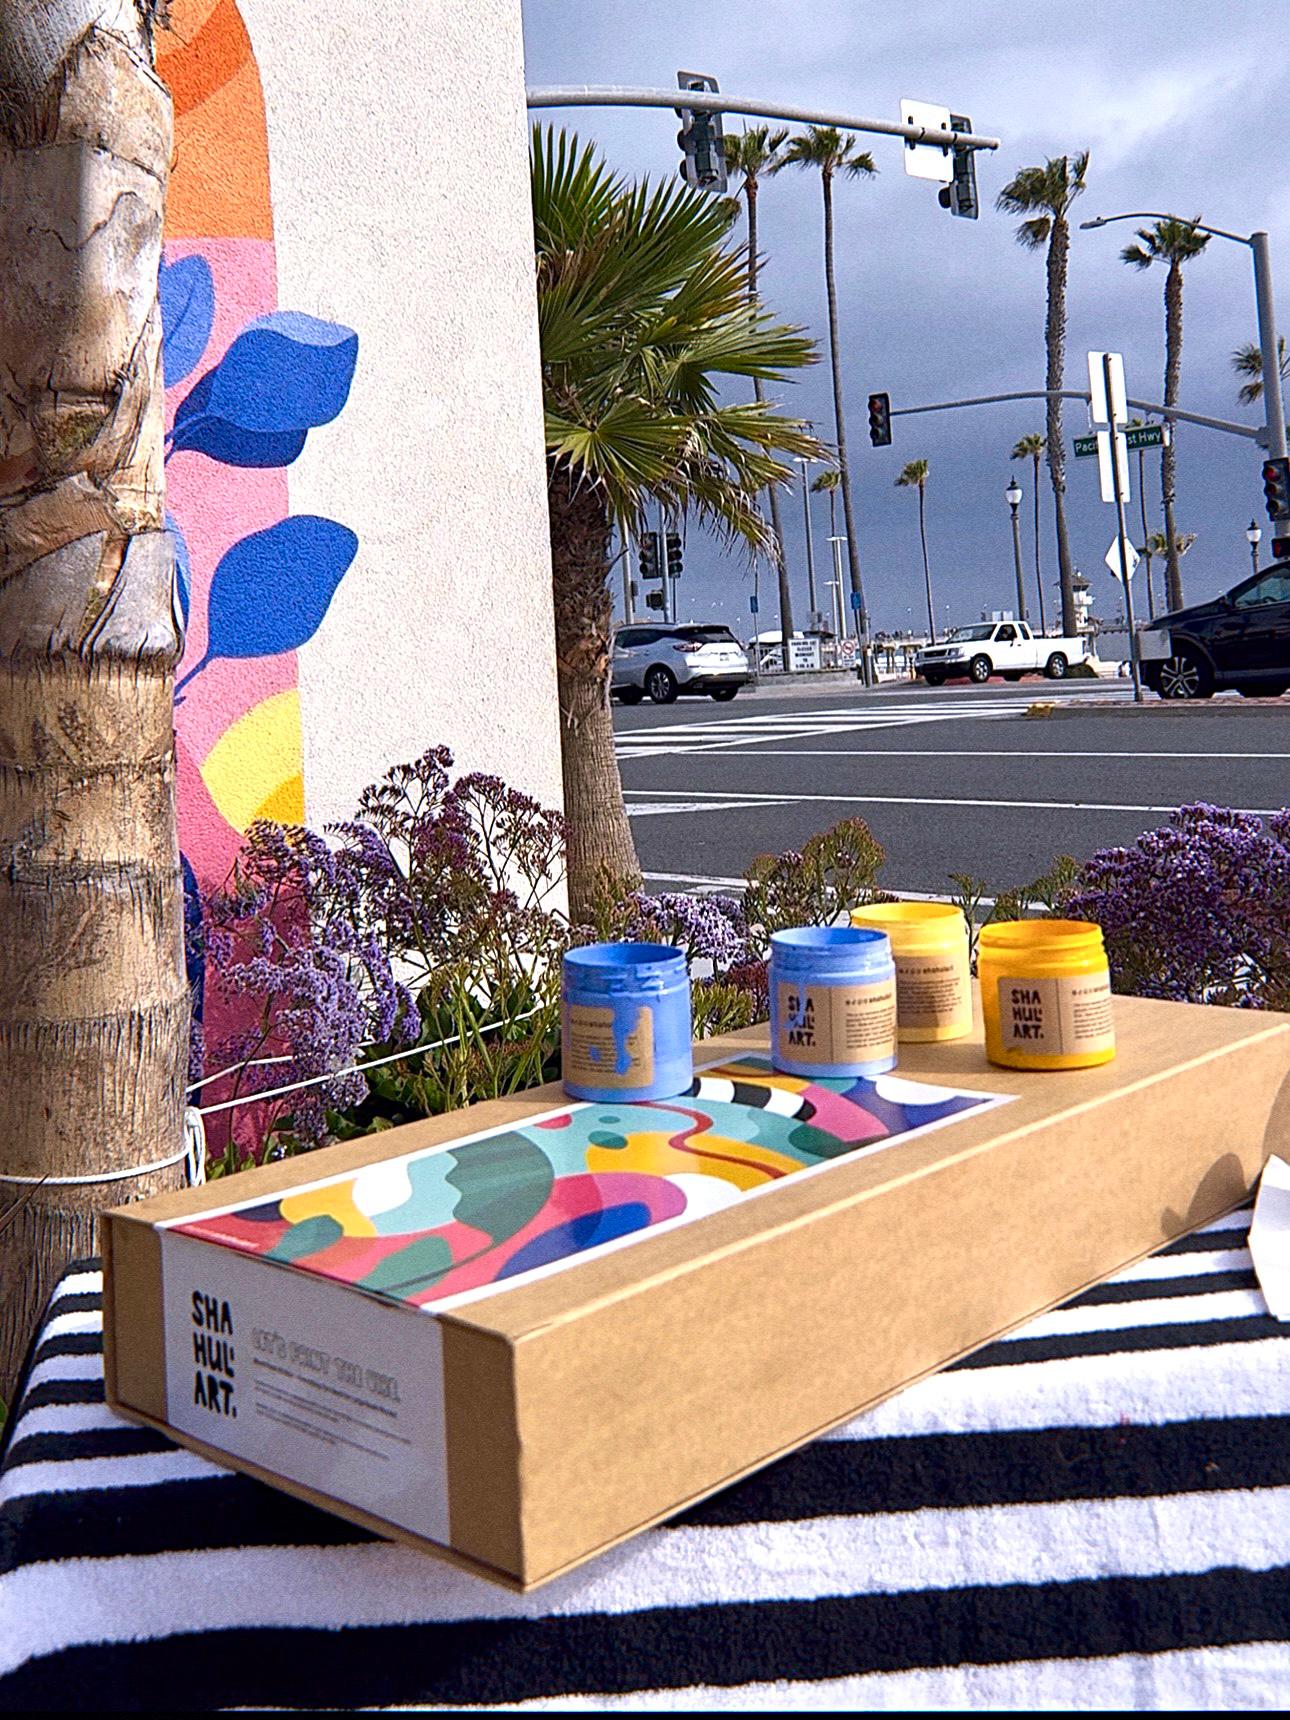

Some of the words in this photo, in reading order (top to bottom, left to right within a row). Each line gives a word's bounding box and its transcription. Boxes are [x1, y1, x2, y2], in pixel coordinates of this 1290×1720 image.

[1138, 431, 1161, 443] Hwy
[1011, 989, 1041, 1005] SHA
[789, 1031, 816, 1046] ART.
[1013, 1024, 1044, 1039] ART.
[192, 1290, 233, 1335] SHA
[194, 1370, 237, 1418] ART.
